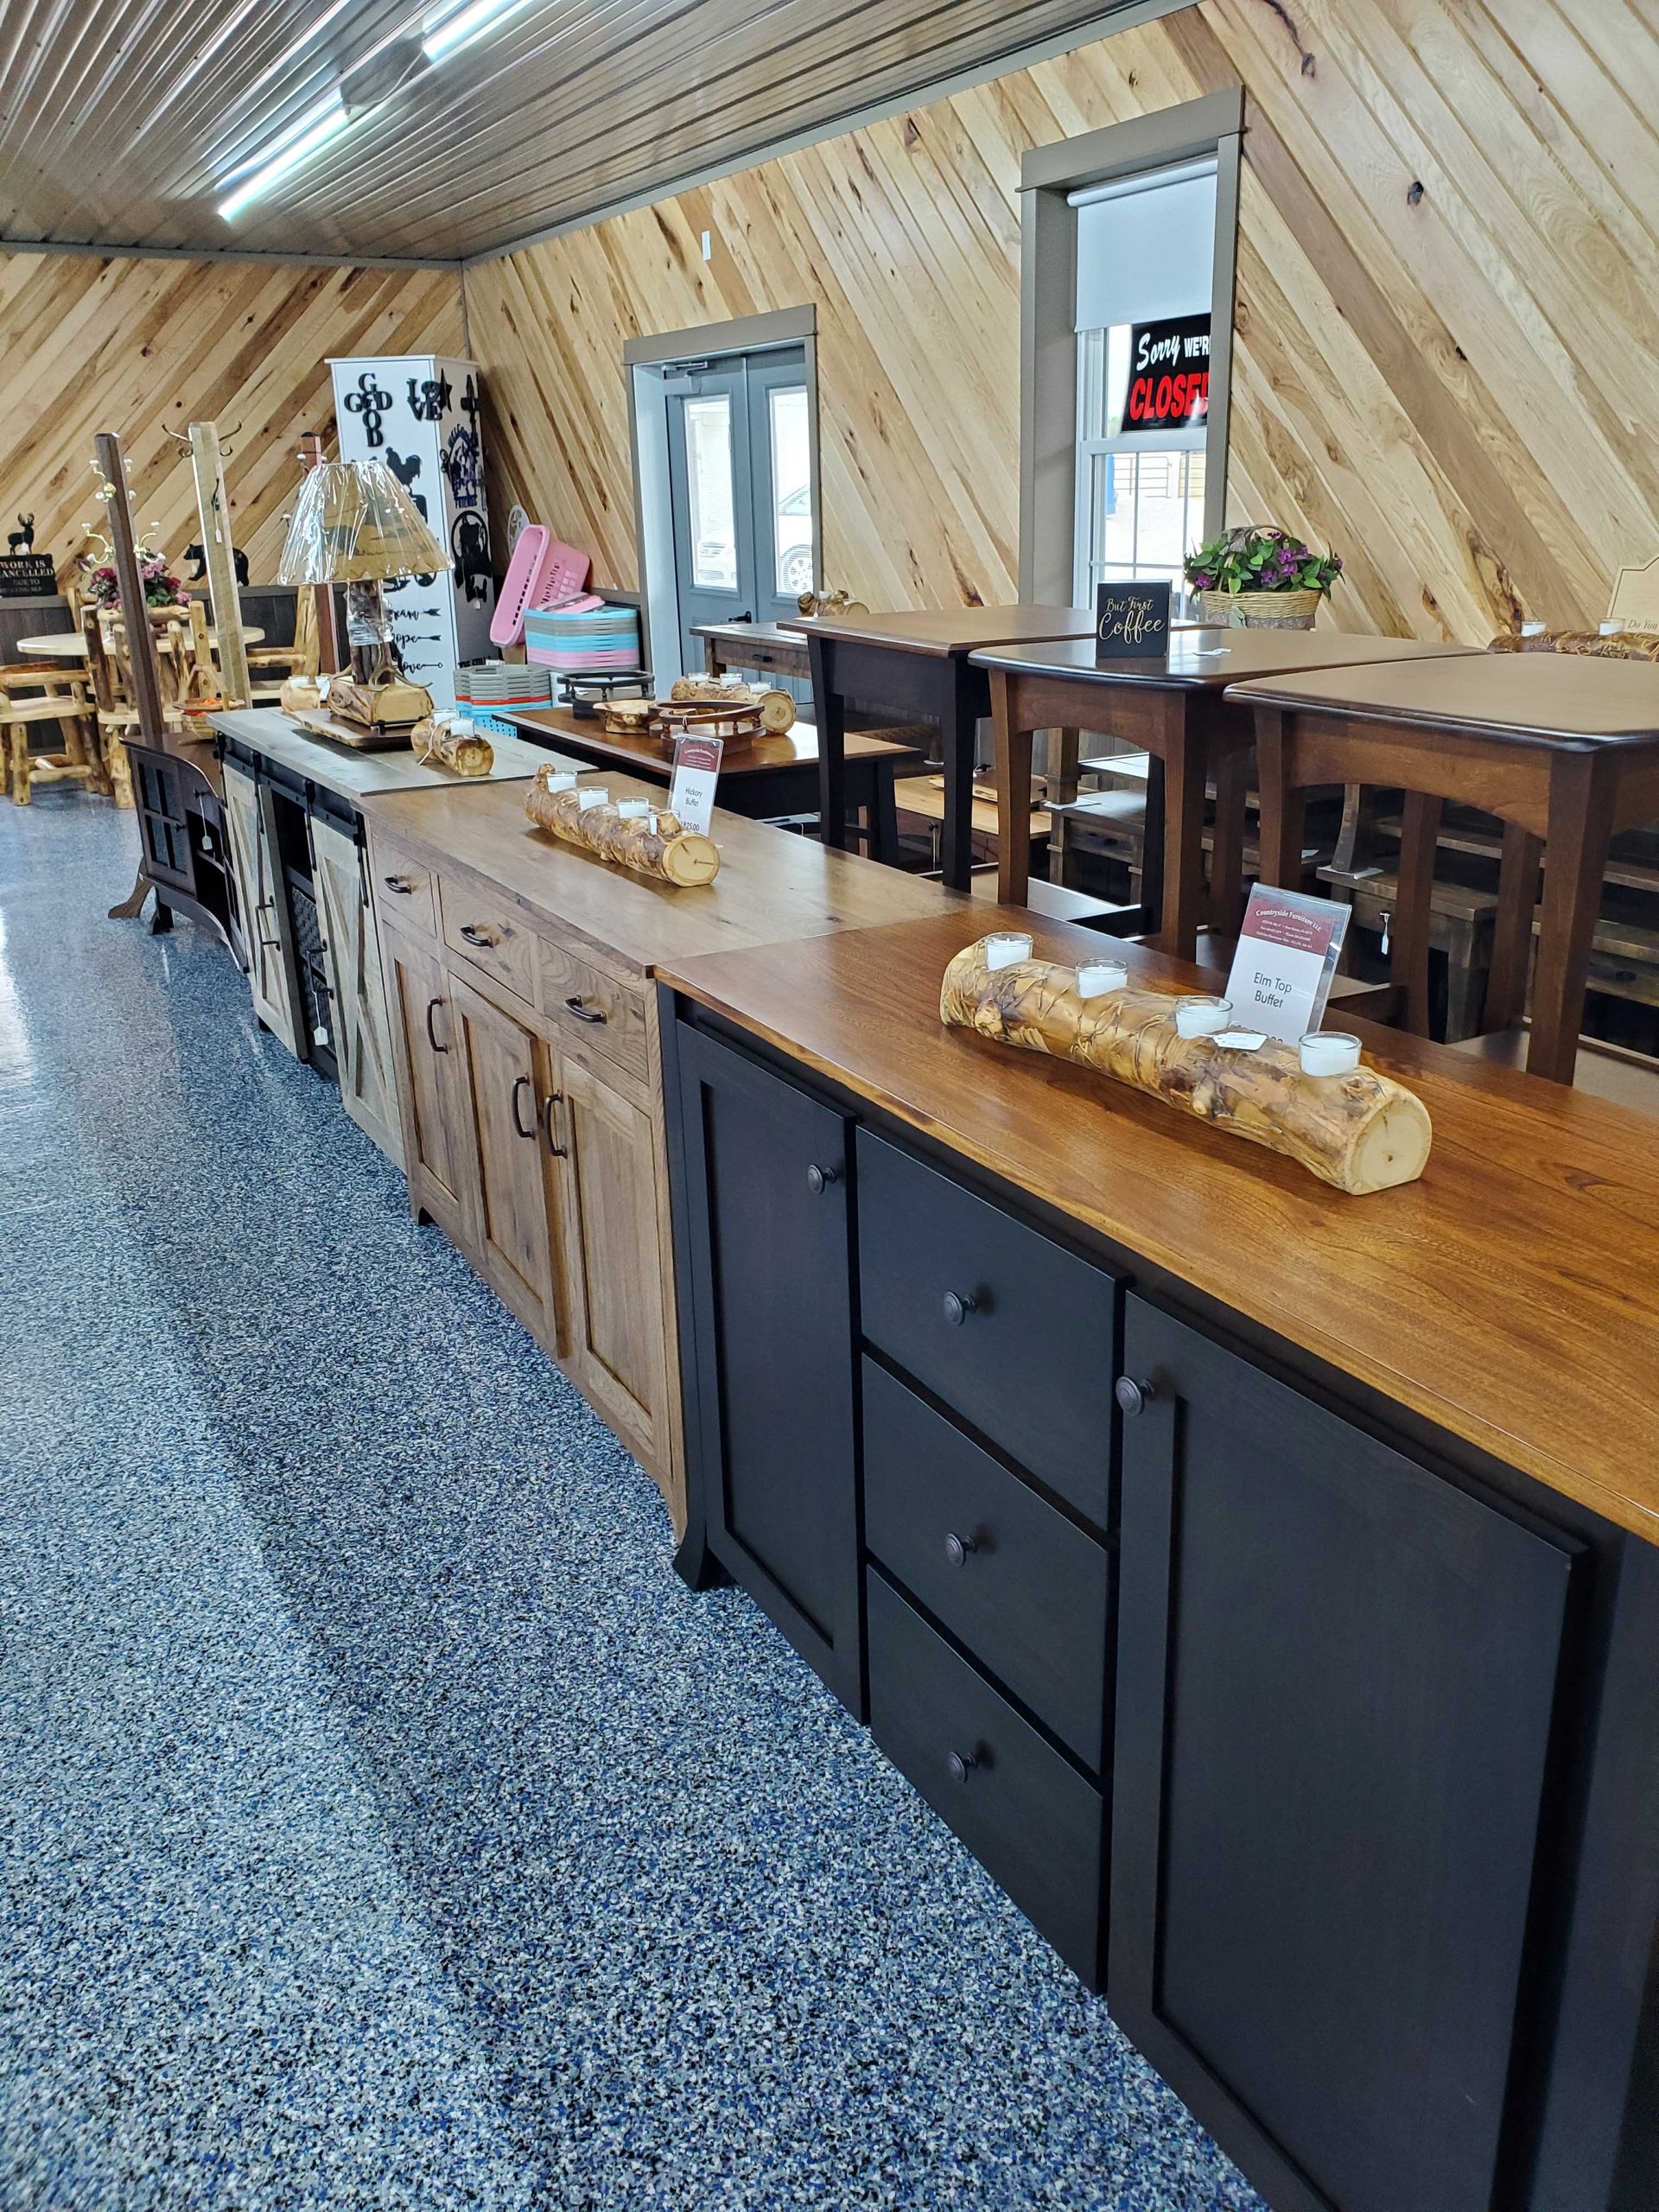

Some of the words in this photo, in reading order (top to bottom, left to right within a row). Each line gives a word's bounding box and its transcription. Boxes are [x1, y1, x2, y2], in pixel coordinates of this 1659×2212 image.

[1136, 333, 1180, 372] Sorry
[1184, 334, 1211, 358] WE'R
[0, 569, 54, 578] ANCELLED
[35, 560, 46, 569] IS
[1106, 598, 1127, 613] But
[1128, 595, 1155, 611] First
[1099, 610, 1165, 645] Coffee
[1628, 619, 1641, 629] Do
[1255, 909, 1289, 918] Countryside
[1288, 911, 1313, 927] Furniture
[1313, 922, 1323, 934] LLC
[1254, 972, 1272, 988] Elm
[1274, 977, 1293, 995] Top
[1255, 989, 1284, 1008] Buffet
